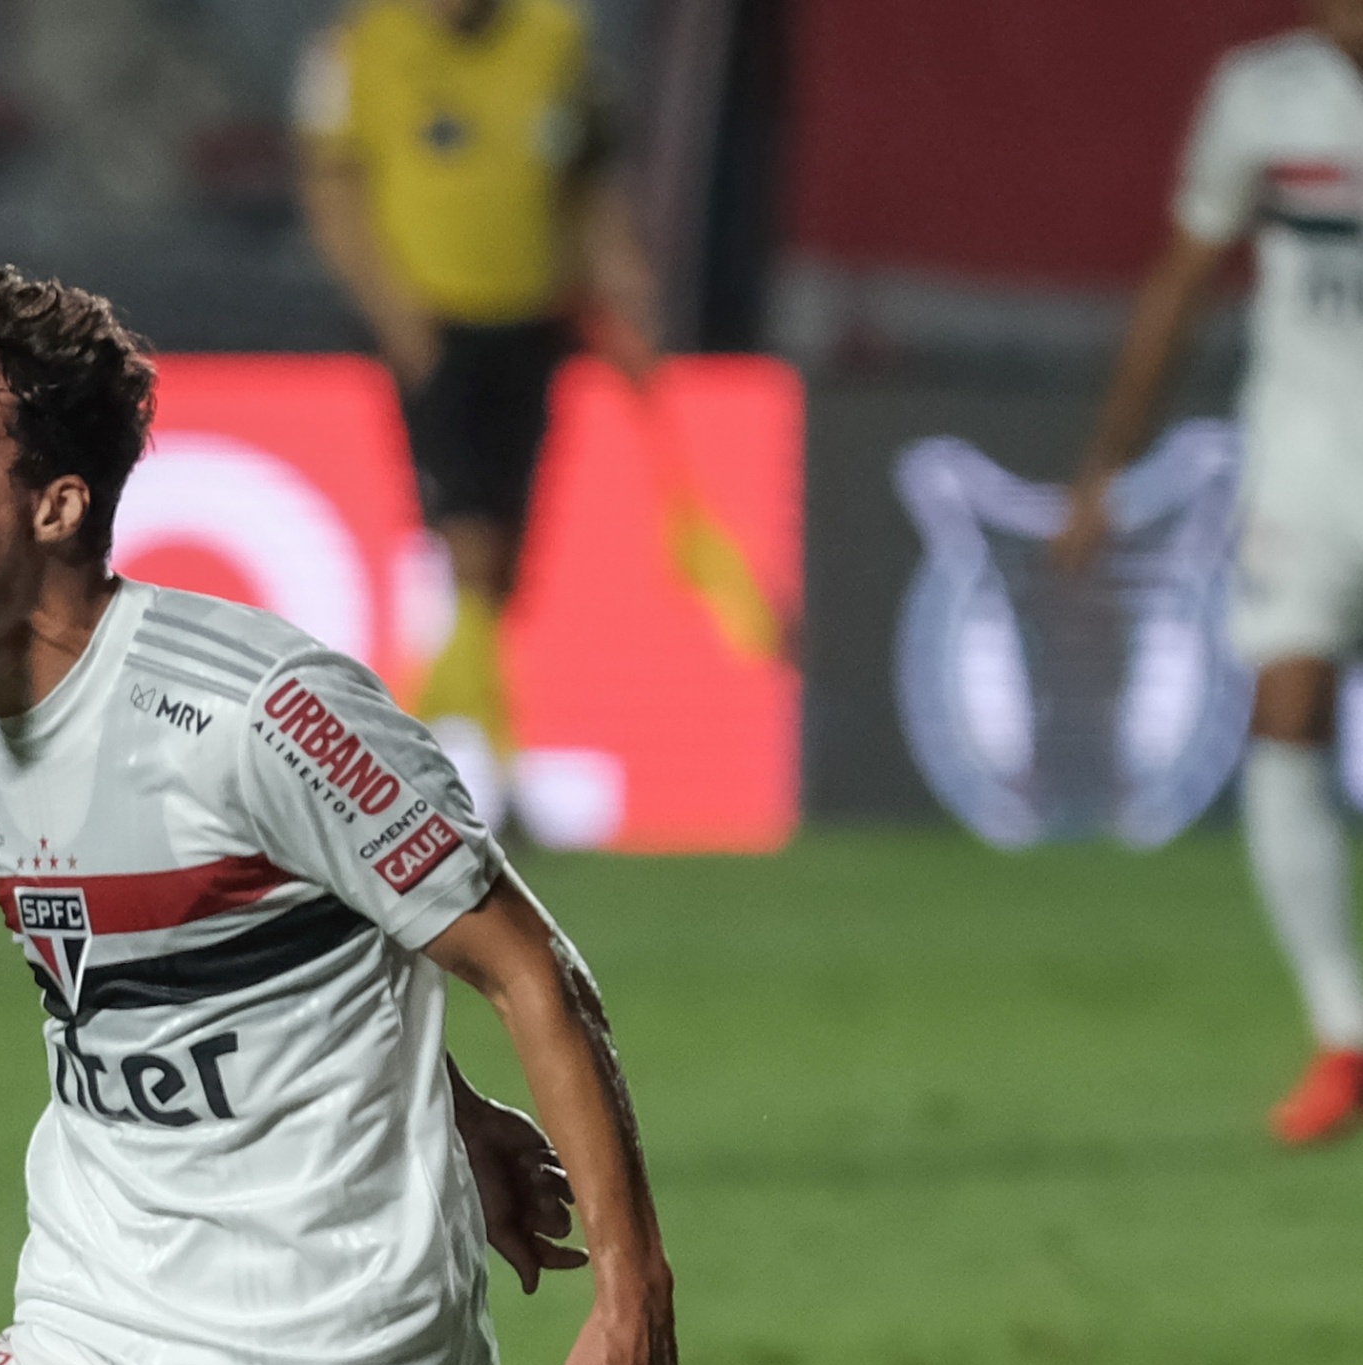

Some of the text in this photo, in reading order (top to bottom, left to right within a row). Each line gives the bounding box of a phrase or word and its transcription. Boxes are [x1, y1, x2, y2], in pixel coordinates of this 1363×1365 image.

[155, 694, 213, 736] MRV
[264, 677, 401, 816] URBANO
[252, 721, 358, 824] ALIMENTOS
[359, 799, 428, 860] CIMENTO
[22, 900, 84, 928] SPFC
[55, 1018, 239, 1127] nter
